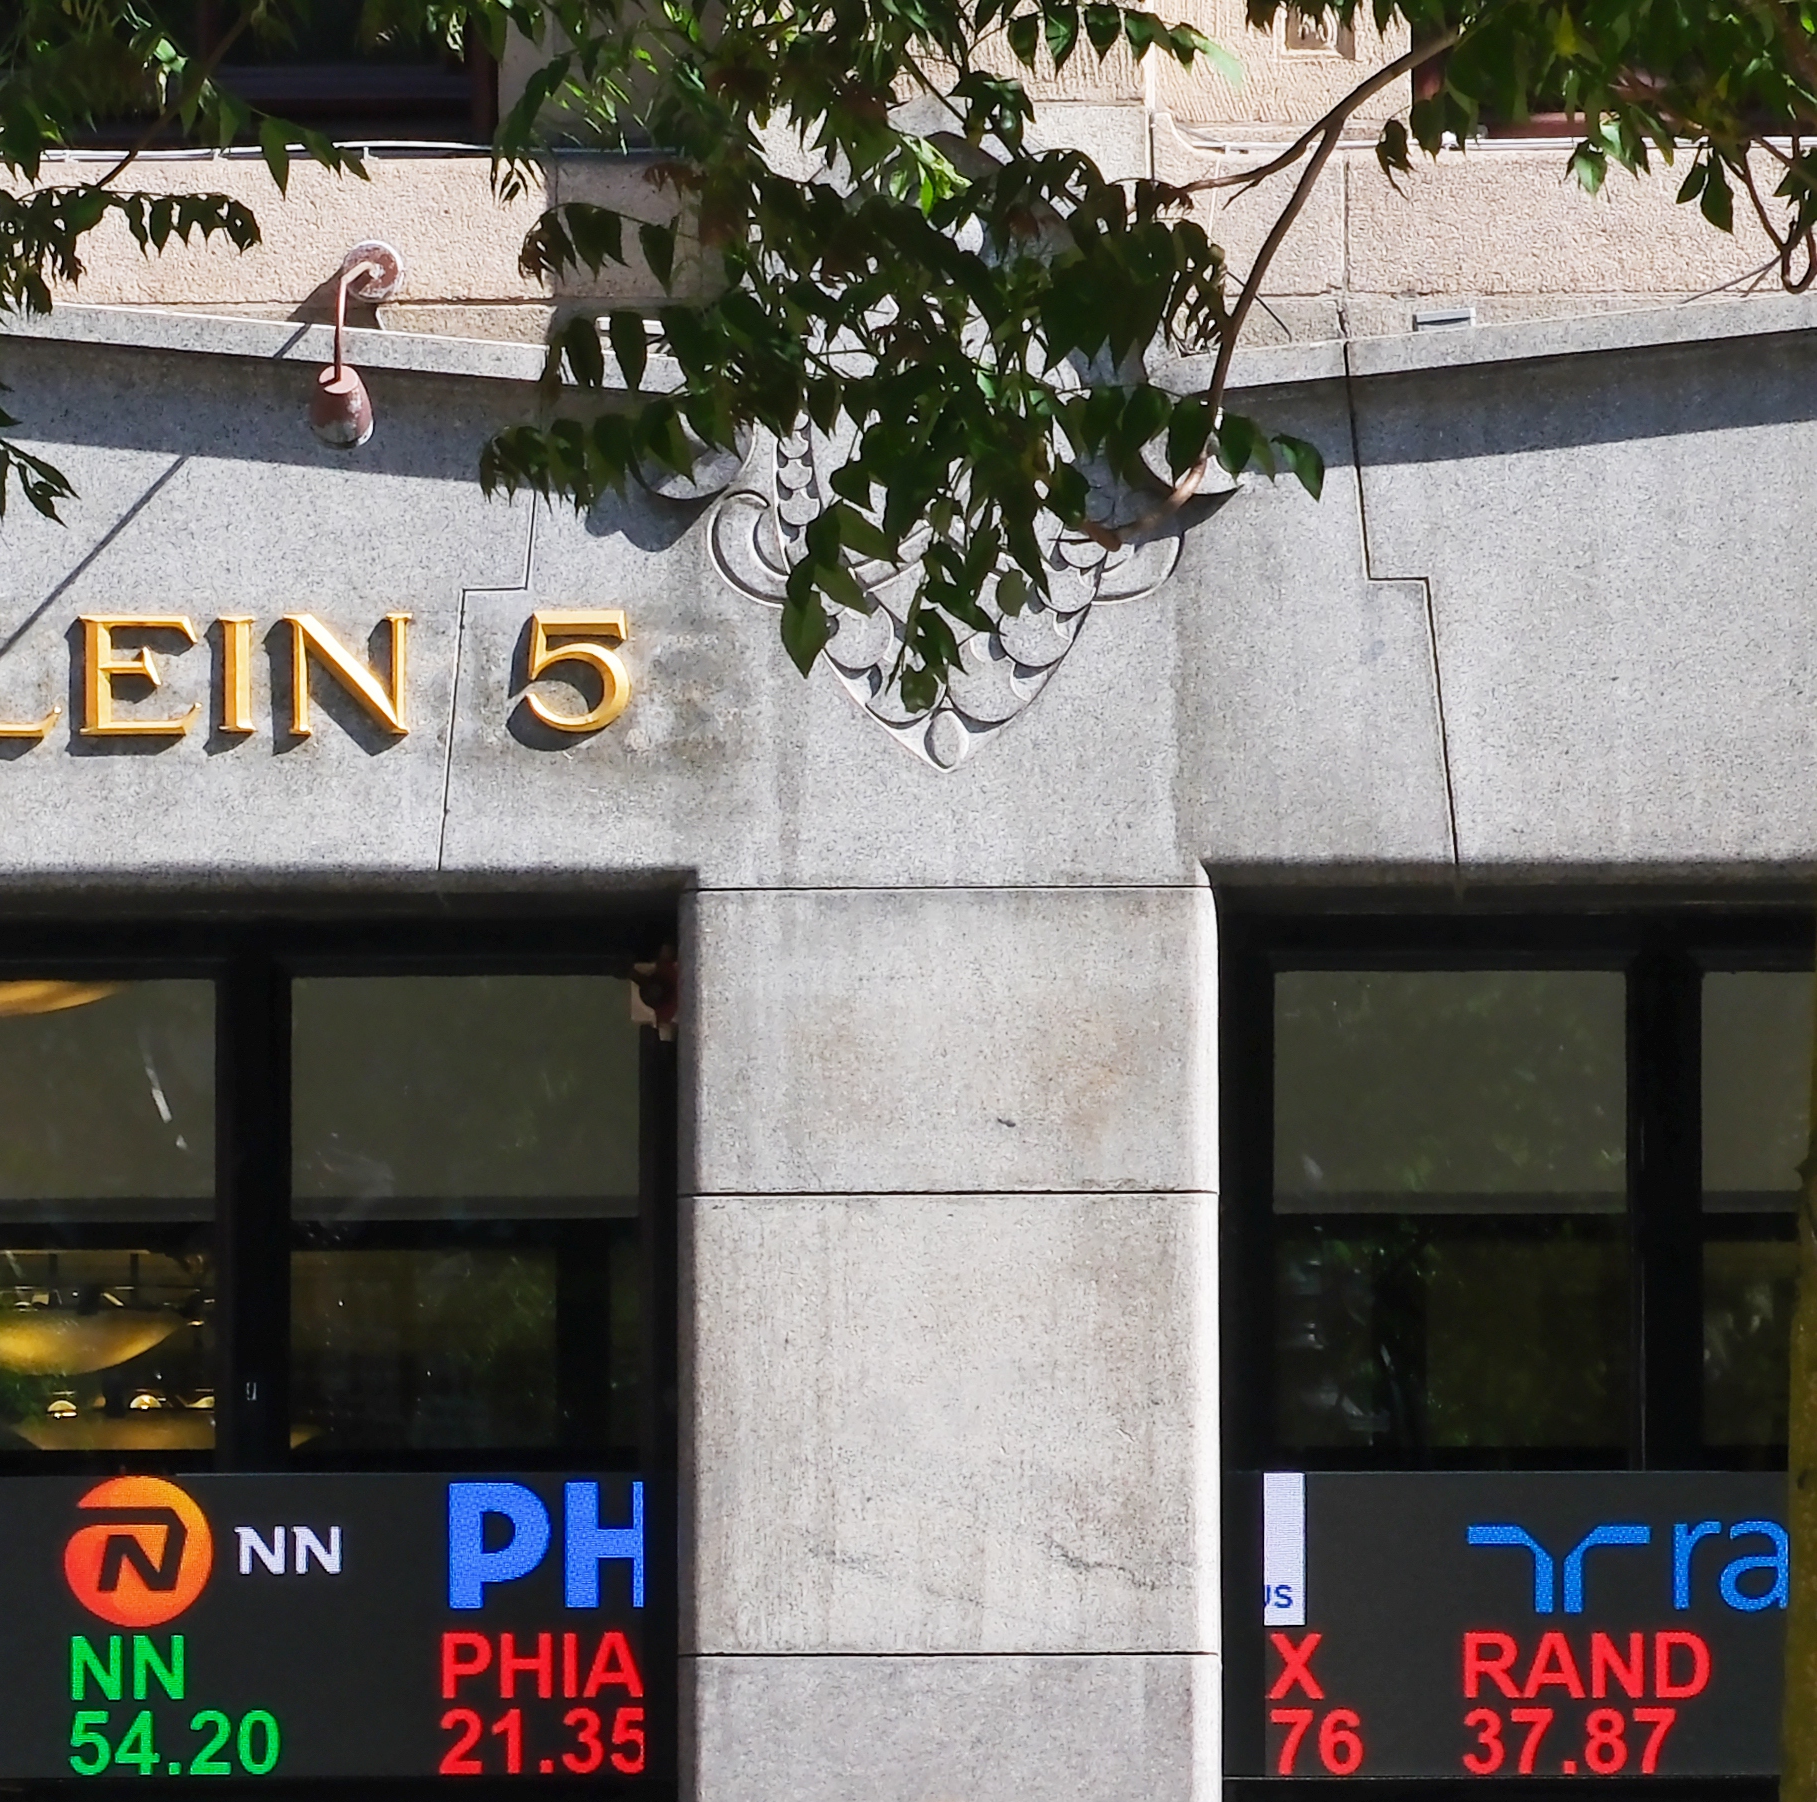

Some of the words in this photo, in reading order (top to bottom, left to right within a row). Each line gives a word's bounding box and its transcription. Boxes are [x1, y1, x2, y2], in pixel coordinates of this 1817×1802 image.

[524, 608, 631, 734] 5
[234, 1525, 344, 1576] NN
[447, 1480, 647, 1610] PH
[1672, 1519, 1790, 1613] ra
[70, 1634, 187, 1702] NN
[440, 1631, 645, 1700] PHIA
[1267, 1632, 1326, 1702] X
[1462, 1631, 1714, 1702] RAND
[69, 1709, 281, 1777] 54.20
[438, 1707, 645, 1776] 21.35
[1269, 1707, 1366, 1777] 76
[1462, 1706, 1678, 1776] 37.87
